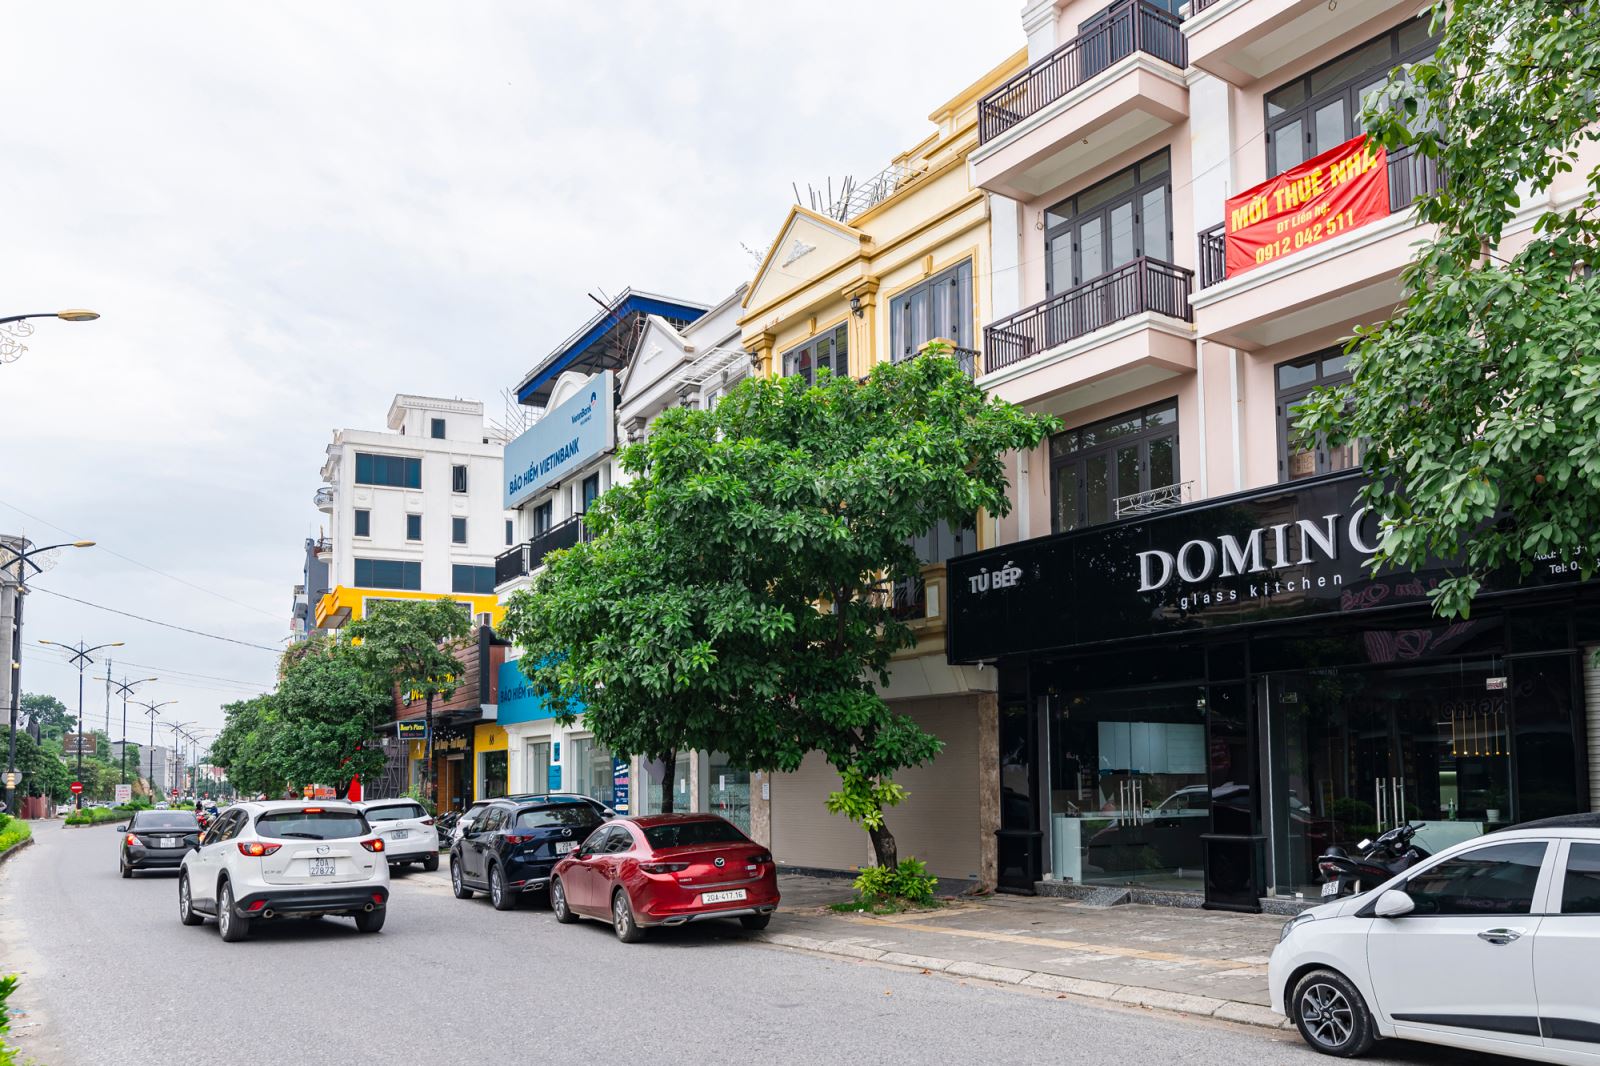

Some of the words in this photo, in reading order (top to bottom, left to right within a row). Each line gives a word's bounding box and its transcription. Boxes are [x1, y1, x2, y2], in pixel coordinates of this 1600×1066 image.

[1231, 195, 1269, 233] MỜI
[1273, 167, 1325, 213] THUÊ
[1255, 237, 1291, 265] 0912
[1294, 223, 1322, 249] 042
[1326, 208, 1354, 235] 511
[509, 474, 522, 495] BẢO
[523, 461, 539, 487] HIỂM
[539, 436, 579, 476] VIETINBANK
[968, 567, 989, 594] TỦ
[992, 560, 1022, 590] BẾP
[1549, 563, 1568, 574] Tel:
[1180, 589, 1237, 610] glass
[1249, 574, 1342, 598] kitchen
[315, 859, 329, 867] 20A
